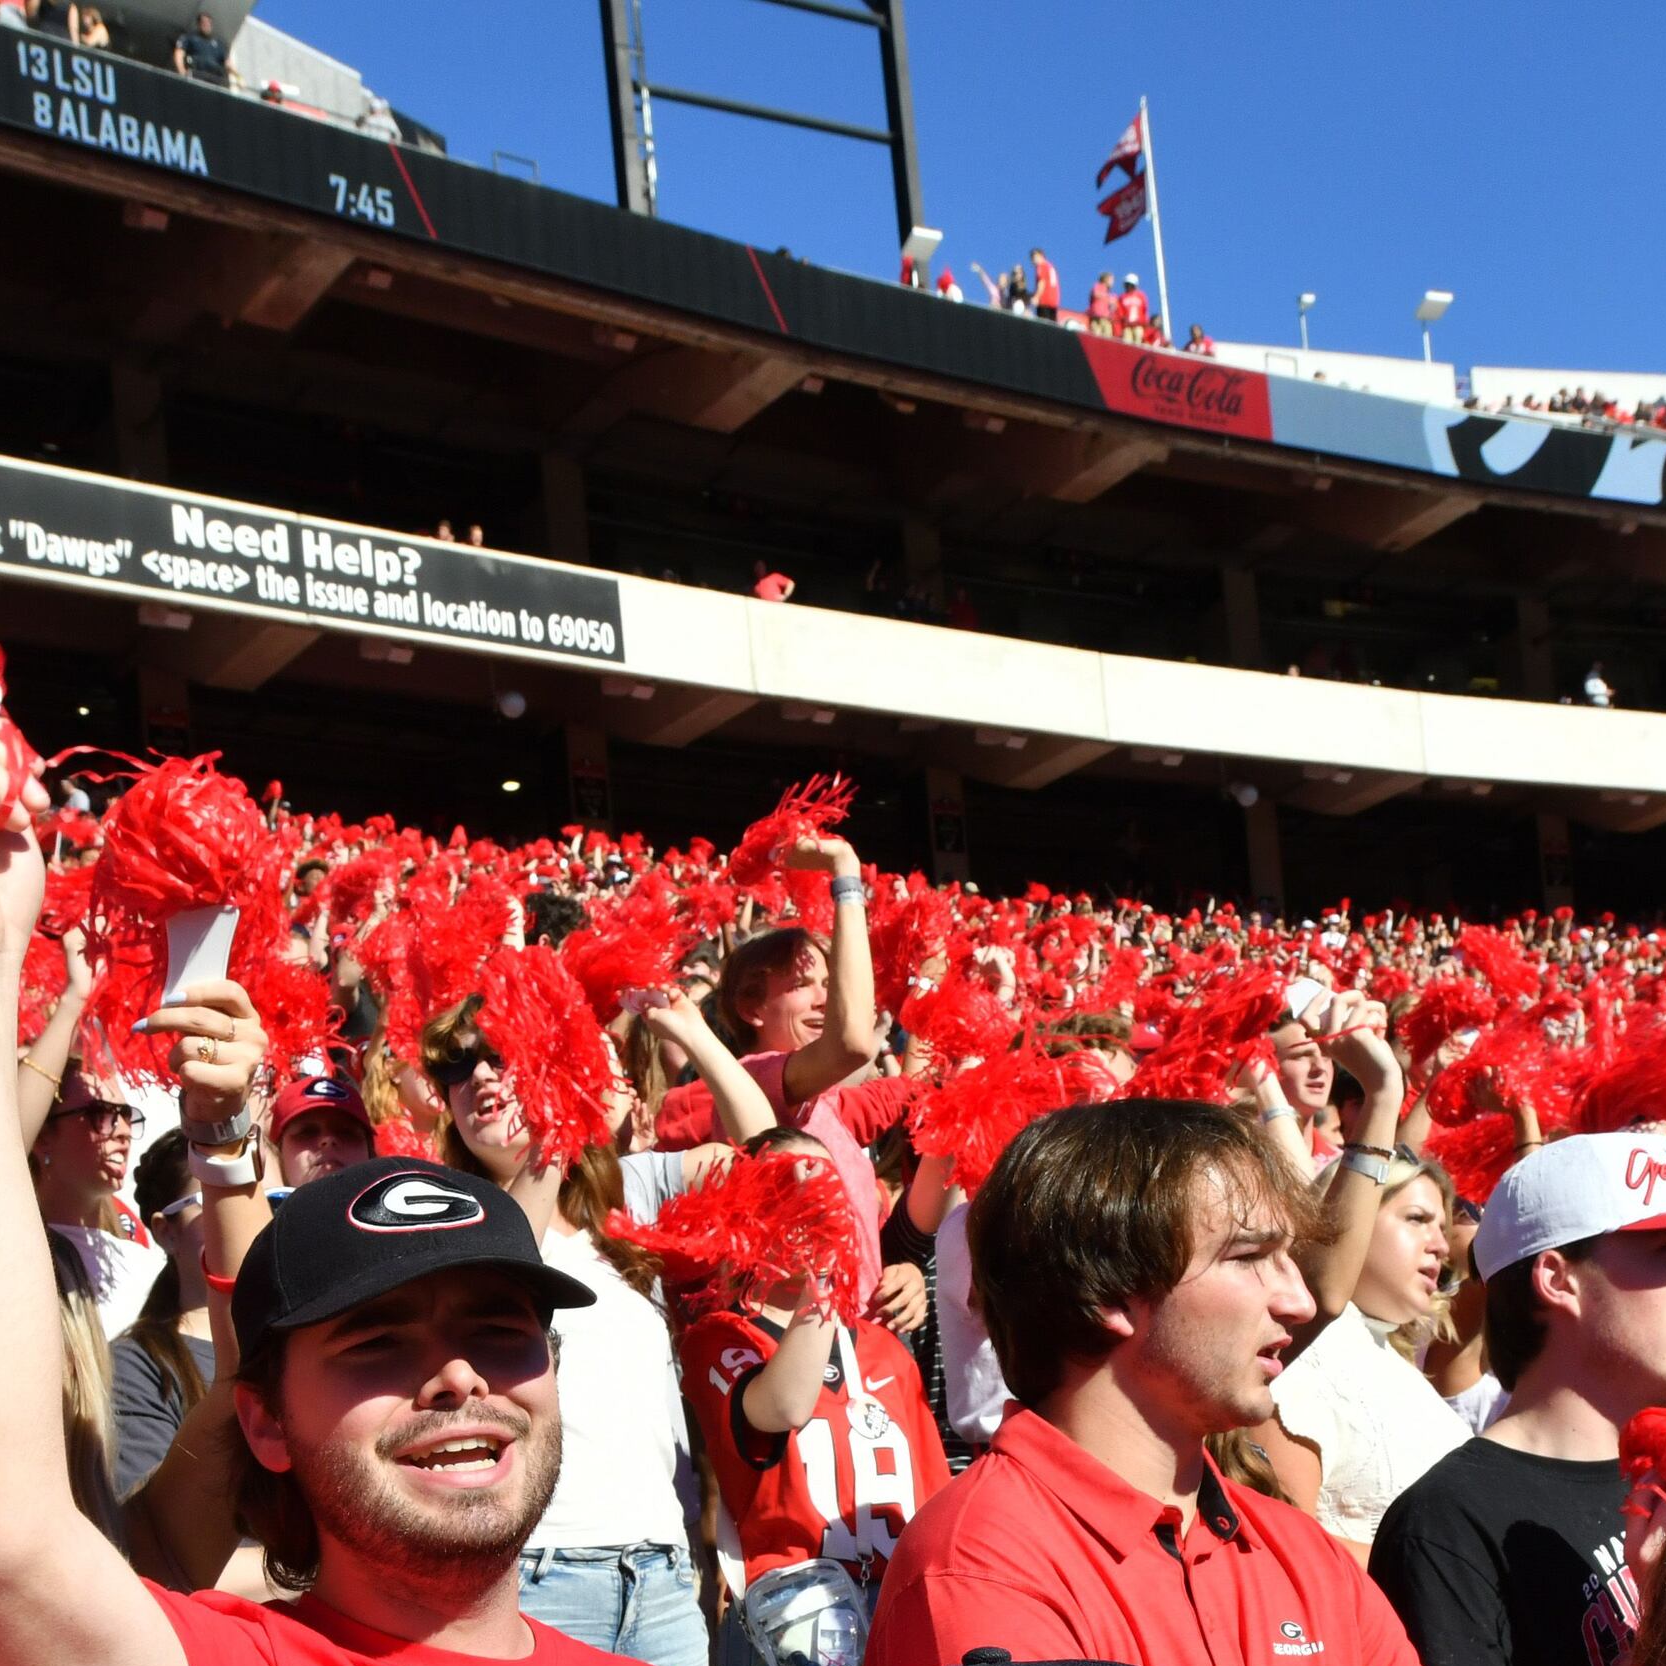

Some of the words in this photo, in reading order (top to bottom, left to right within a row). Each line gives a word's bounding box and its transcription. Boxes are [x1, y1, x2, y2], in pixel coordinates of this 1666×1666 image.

[17, 40, 49, 83] 13
[54, 49, 117, 104] LSU
[33, 92, 52, 129] 8
[58, 101, 209, 175] ALABAMA
[329, 174, 395, 226] 7:45
[171, 504, 290, 564] Need
[302, 528, 423, 586] Help?
[9, 518, 133, 576] "Dawgs"
[141, 550, 250, 590] <space>
[256, 564, 300, 604] the
[305, 572, 368, 615] issue
[373, 589, 419, 623] and
[423, 592, 517, 639] location
[519, 608, 545, 643] to
[547, 613, 616, 655] 69050
